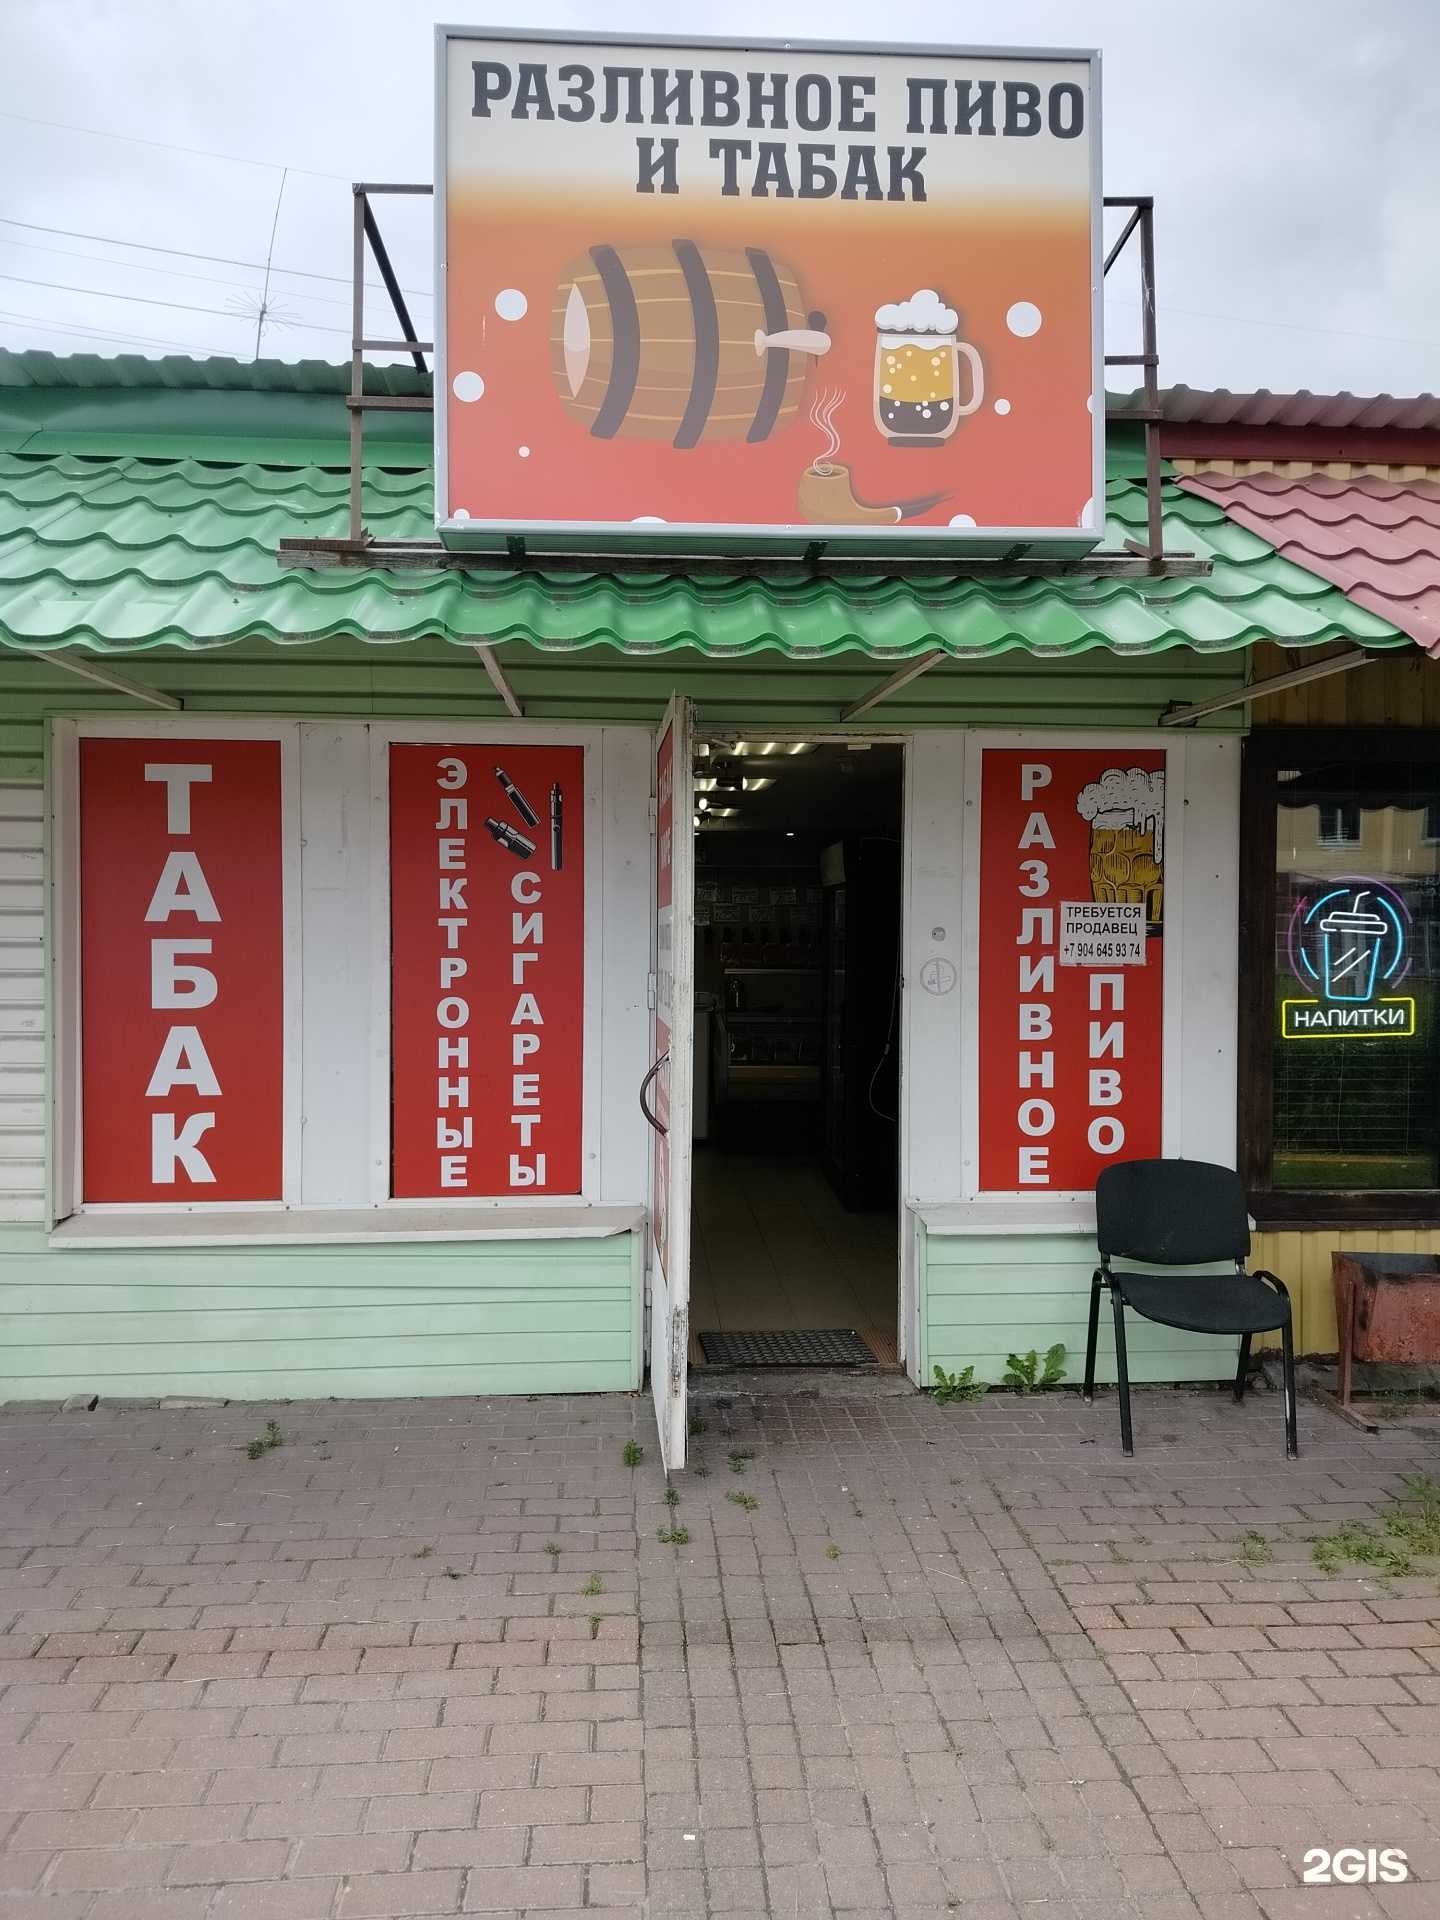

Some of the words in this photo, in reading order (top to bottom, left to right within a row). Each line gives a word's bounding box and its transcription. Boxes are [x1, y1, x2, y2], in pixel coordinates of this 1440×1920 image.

[471, 60, 876, 131] РАЗЛИВНОЕ
[906, 78, 1084, 139] ПИВО
[637, 138, 679, 194] И
[709, 138, 927, 202] ТАБАК
[1064, 943, 1075, 957] +7
[1077, 943, 1094, 957] 904
[1096, 943, 1113, 957] 645
[1115, 943, 1127, 957] 93
[1129, 943, 1141, 957] 74
[1066, 906, 1141, 918] ТРЕБУЕТСЯ
[1066, 922, 1138, 935] ПРОДАВЕЦ
[144, 764, 222, 1183] ТАБАК
[436, 759, 472, 1187] ЭЛЕКТРОННЫЕ
[1017, 765, 1055, 1183] РАЗЛИВНОЕ
[510, 872, 545, 1186] СИГАРЕТЫ
[1295, 1008, 1404, 1027] НАПИТКИ
[1088, 974, 1124, 1154] ПИВО
